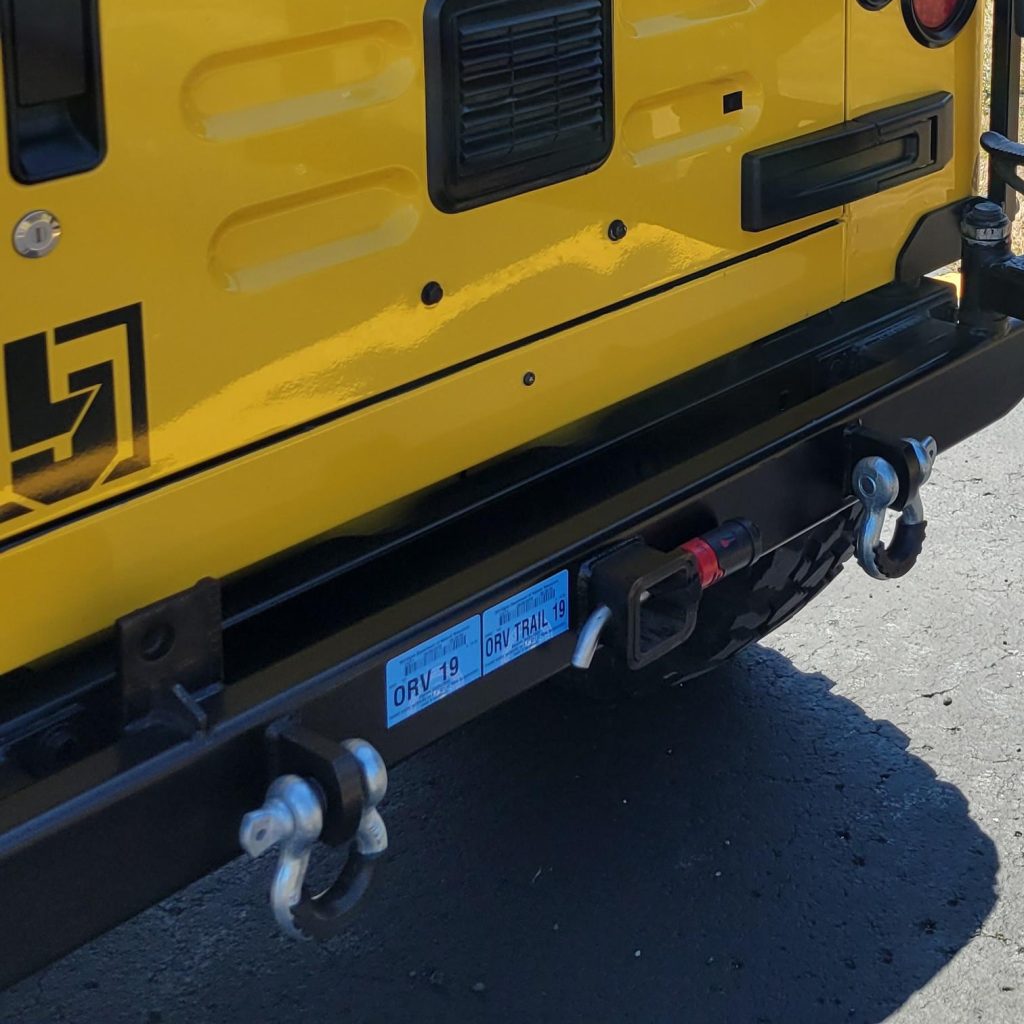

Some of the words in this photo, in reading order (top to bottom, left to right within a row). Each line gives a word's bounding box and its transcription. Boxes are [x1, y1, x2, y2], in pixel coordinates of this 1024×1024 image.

[485, 632, 511, 658] ORV
[514, 609, 549, 639] TRAIL
[552, 599, 566, 620] 19
[393, 670, 432, 707] ORV
[439, 656, 459, 681] 19
